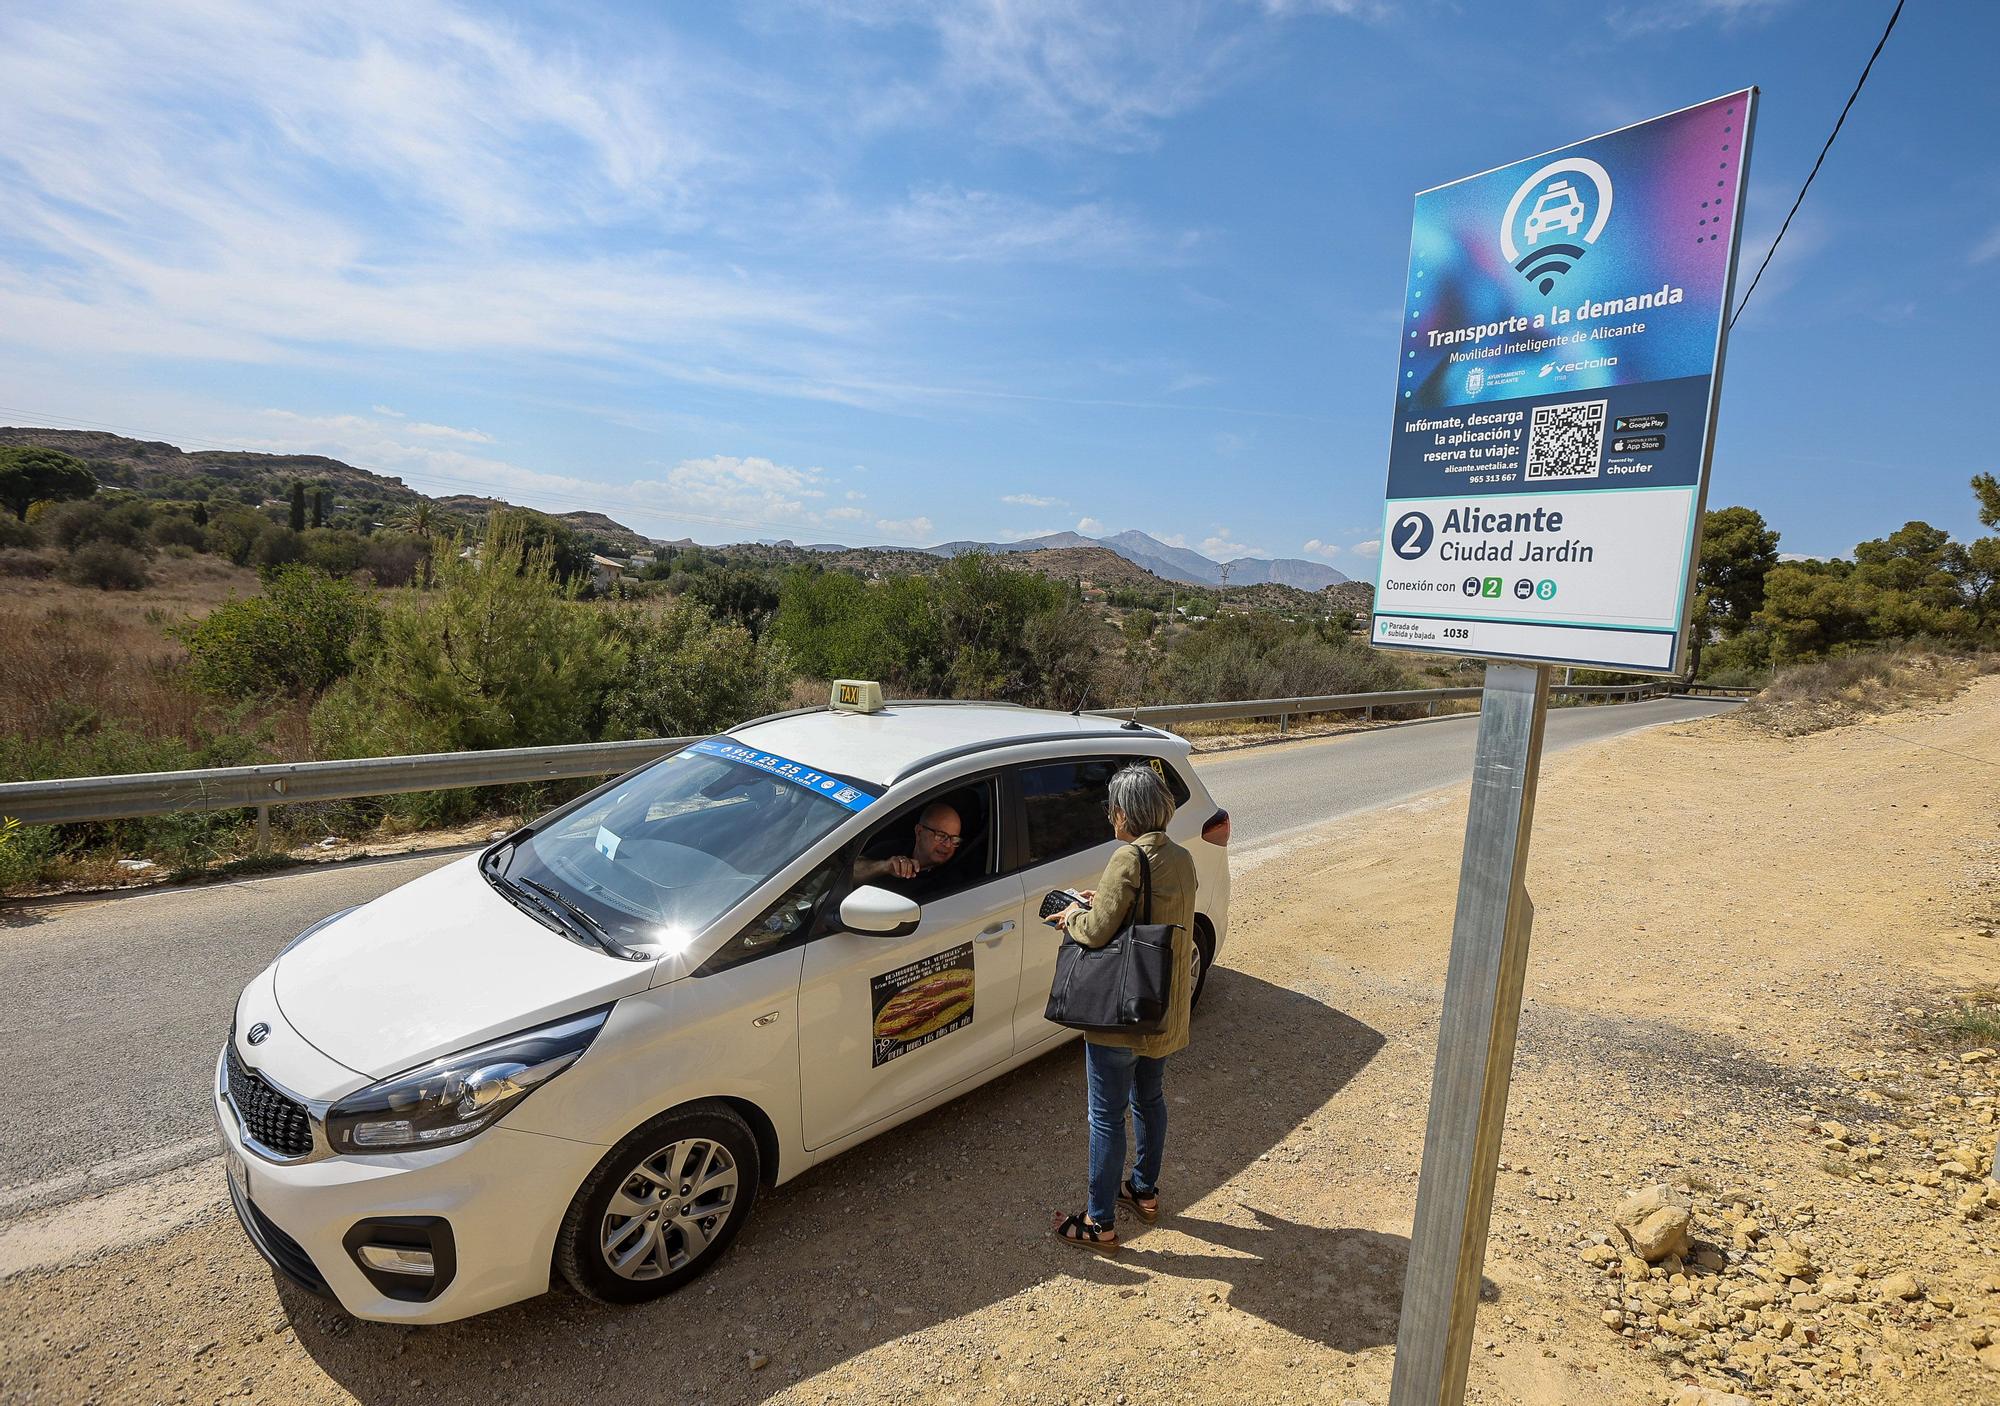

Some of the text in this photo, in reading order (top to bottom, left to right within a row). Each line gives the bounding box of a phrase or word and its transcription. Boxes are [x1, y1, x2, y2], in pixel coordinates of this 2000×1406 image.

[1427, 284, 1684, 347] Transporte a la demanda
[1449, 321, 1646, 363] Movilidad Inteligente de Alicante
[1555, 356, 1618, 373] vectalia
[1488, 370, 1526, 380] AYUNTAMIENTO
[1494, 378, 1519, 386] ALICANTE
[1405, 410, 1524, 433] Infórmate, descarga
[1629, 420, 1651, 429] Google
[1434, 426, 1522, 448] la aplicación y
[1423, 442, 1520, 463] reserva tu viaje:
[1444, 461, 1518, 474] alicante.vectalia.es
[1607, 463, 1653, 475] choufer
[1469, 473, 1517, 484] 965 313 667
[1441, 506, 1563, 534] Alicante
[1399, 515, 1425, 554] 2
[1440, 539, 1594, 563] Ciudad Jardín
[1386, 579, 1552, 598] Conexión con 2 8
[1389, 622, 1410, 630] Parada
[1443, 628, 1469, 639] 1038
[1414, 632, 1435, 640] bajada
[841, 685, 859, 703] TAXI
[732, 748, 822, 783] 965 25 25 11
